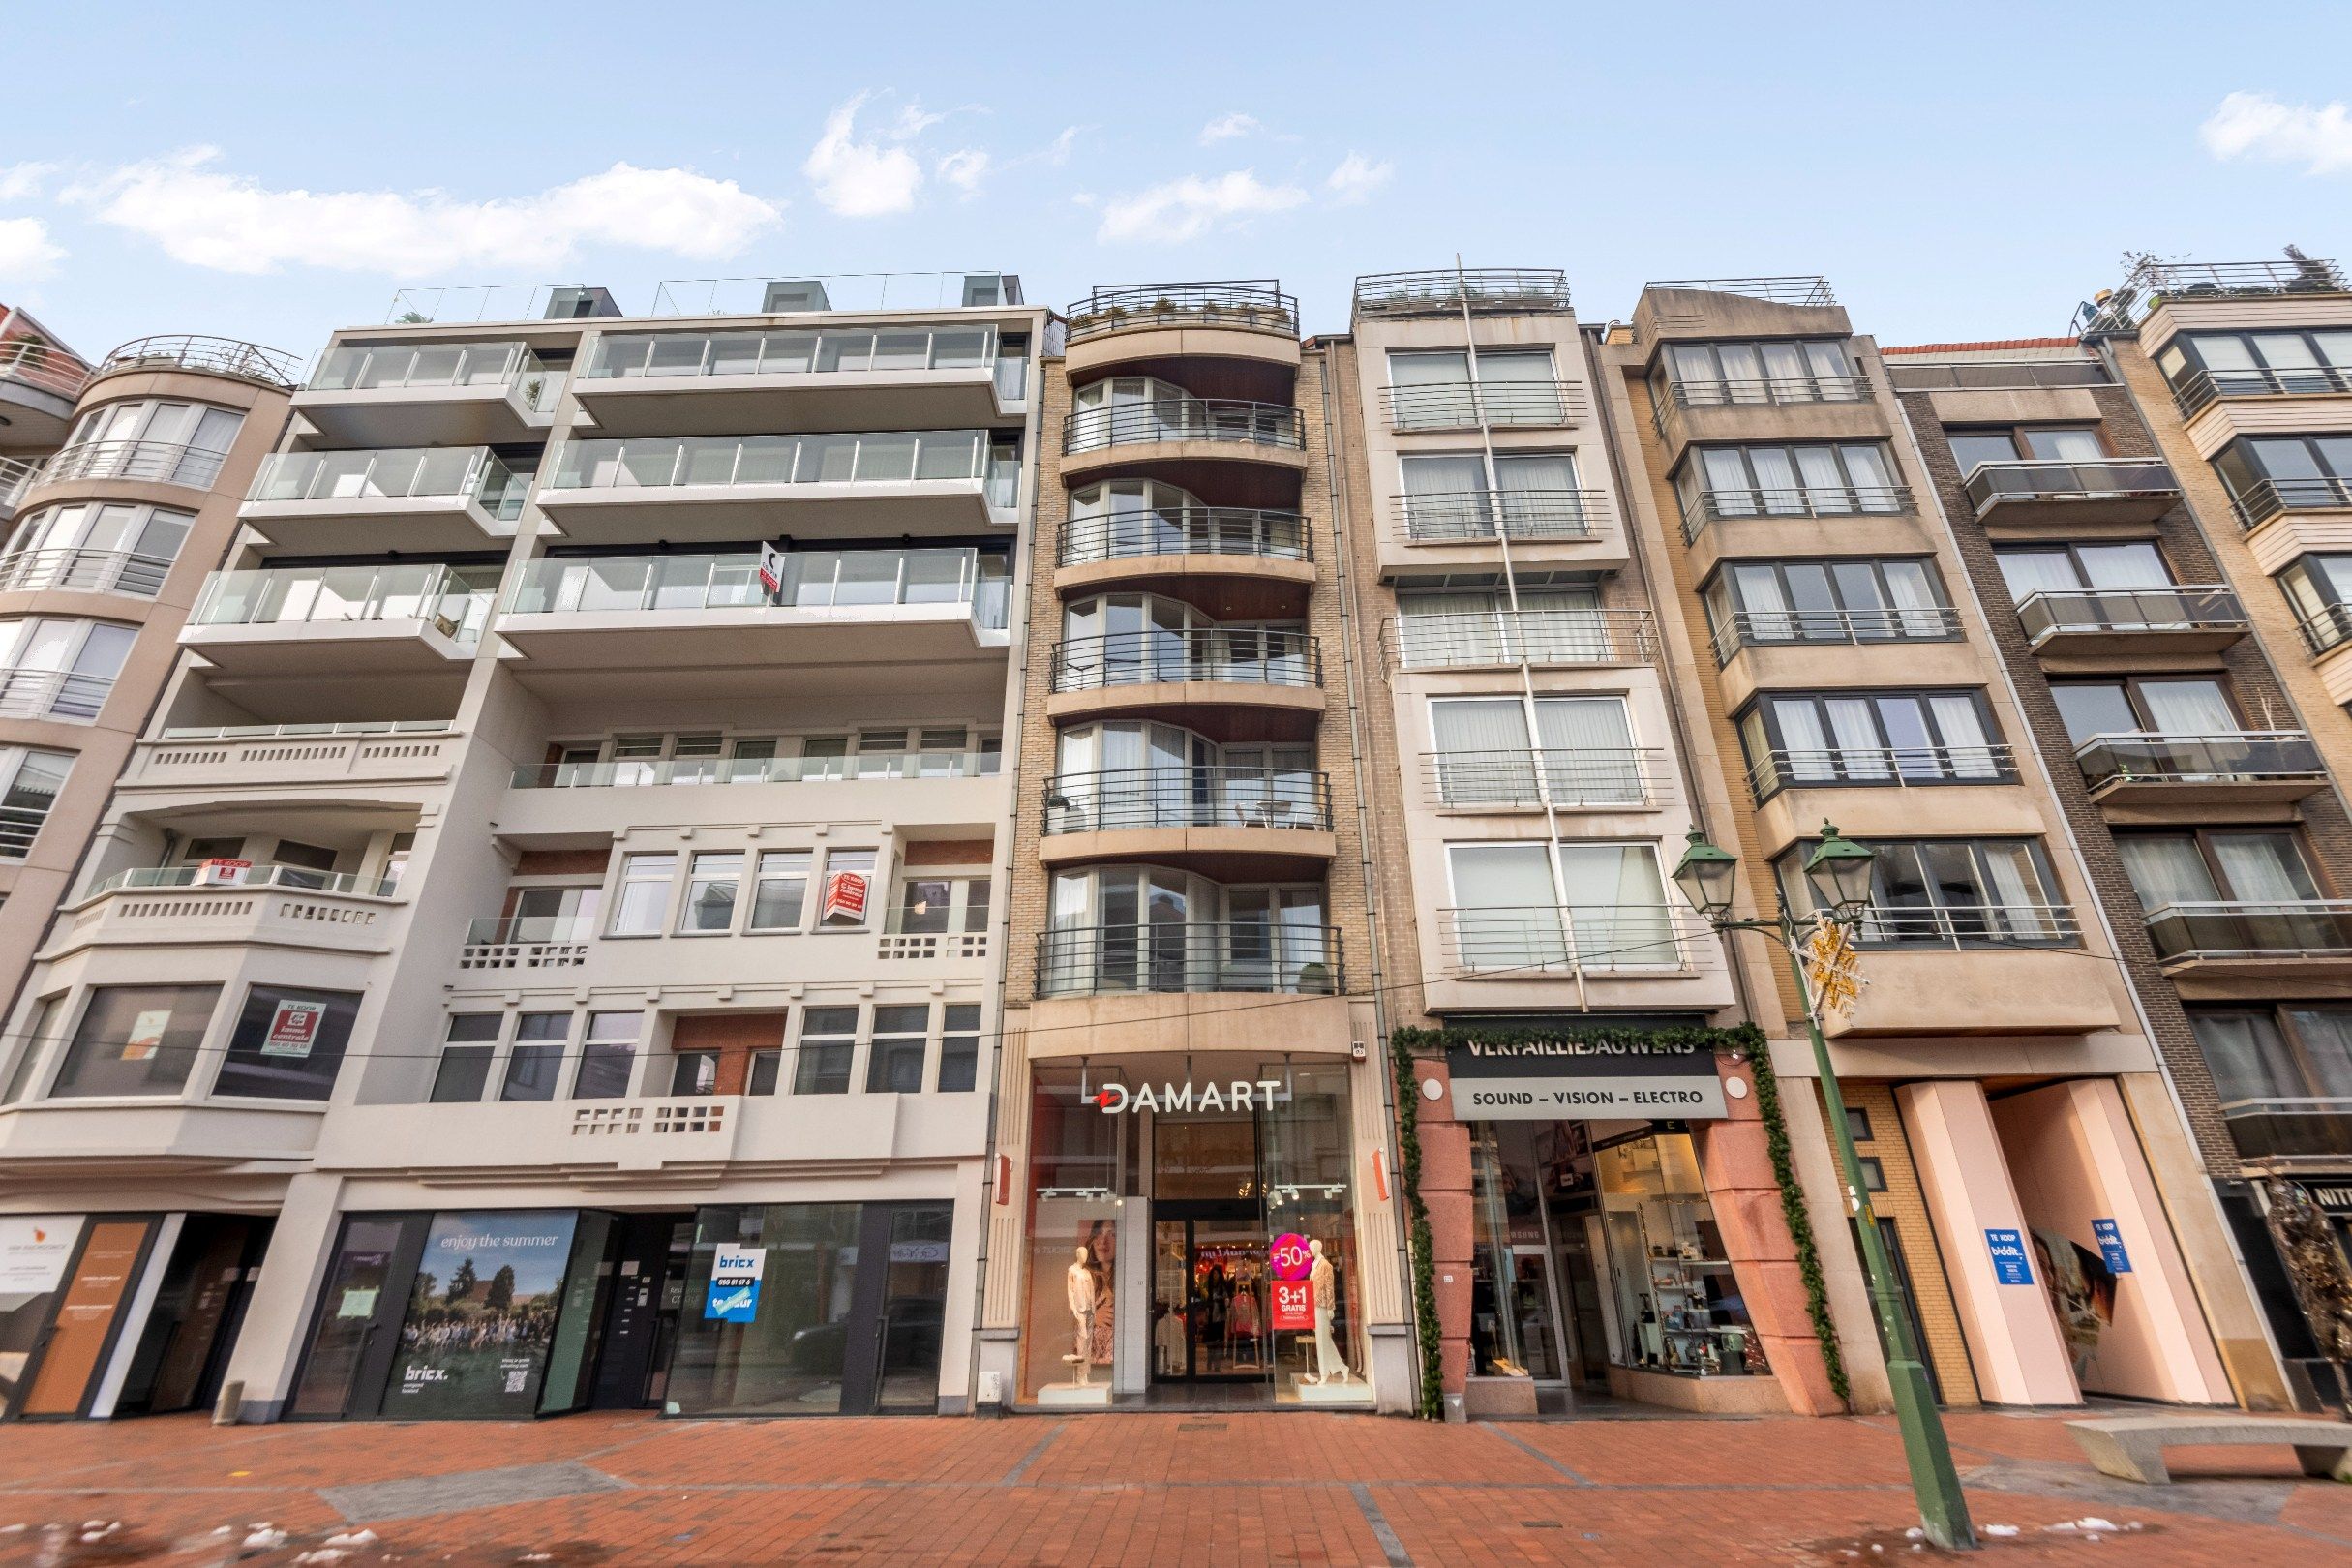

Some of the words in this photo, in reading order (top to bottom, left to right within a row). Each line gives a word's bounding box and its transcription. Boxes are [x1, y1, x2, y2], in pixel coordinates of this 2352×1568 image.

[1101, 1080, 1282, 1114] DAMART
[1472, 1092, 1534, 1106] SOUND
[1553, 1091, 1614, 1105] VISION
[1634, 1090, 1704, 1104] ELECTRO
[440, 1235, 478, 1251] enjoy
[479, 1234, 500, 1247] the
[503, 1235, 558, 1247] summer
[719, 1255, 755, 1268] bricx
[1279, 1286, 1307, 1305] 3+1
[1281, 1304, 1307, 1312] GRATIS
